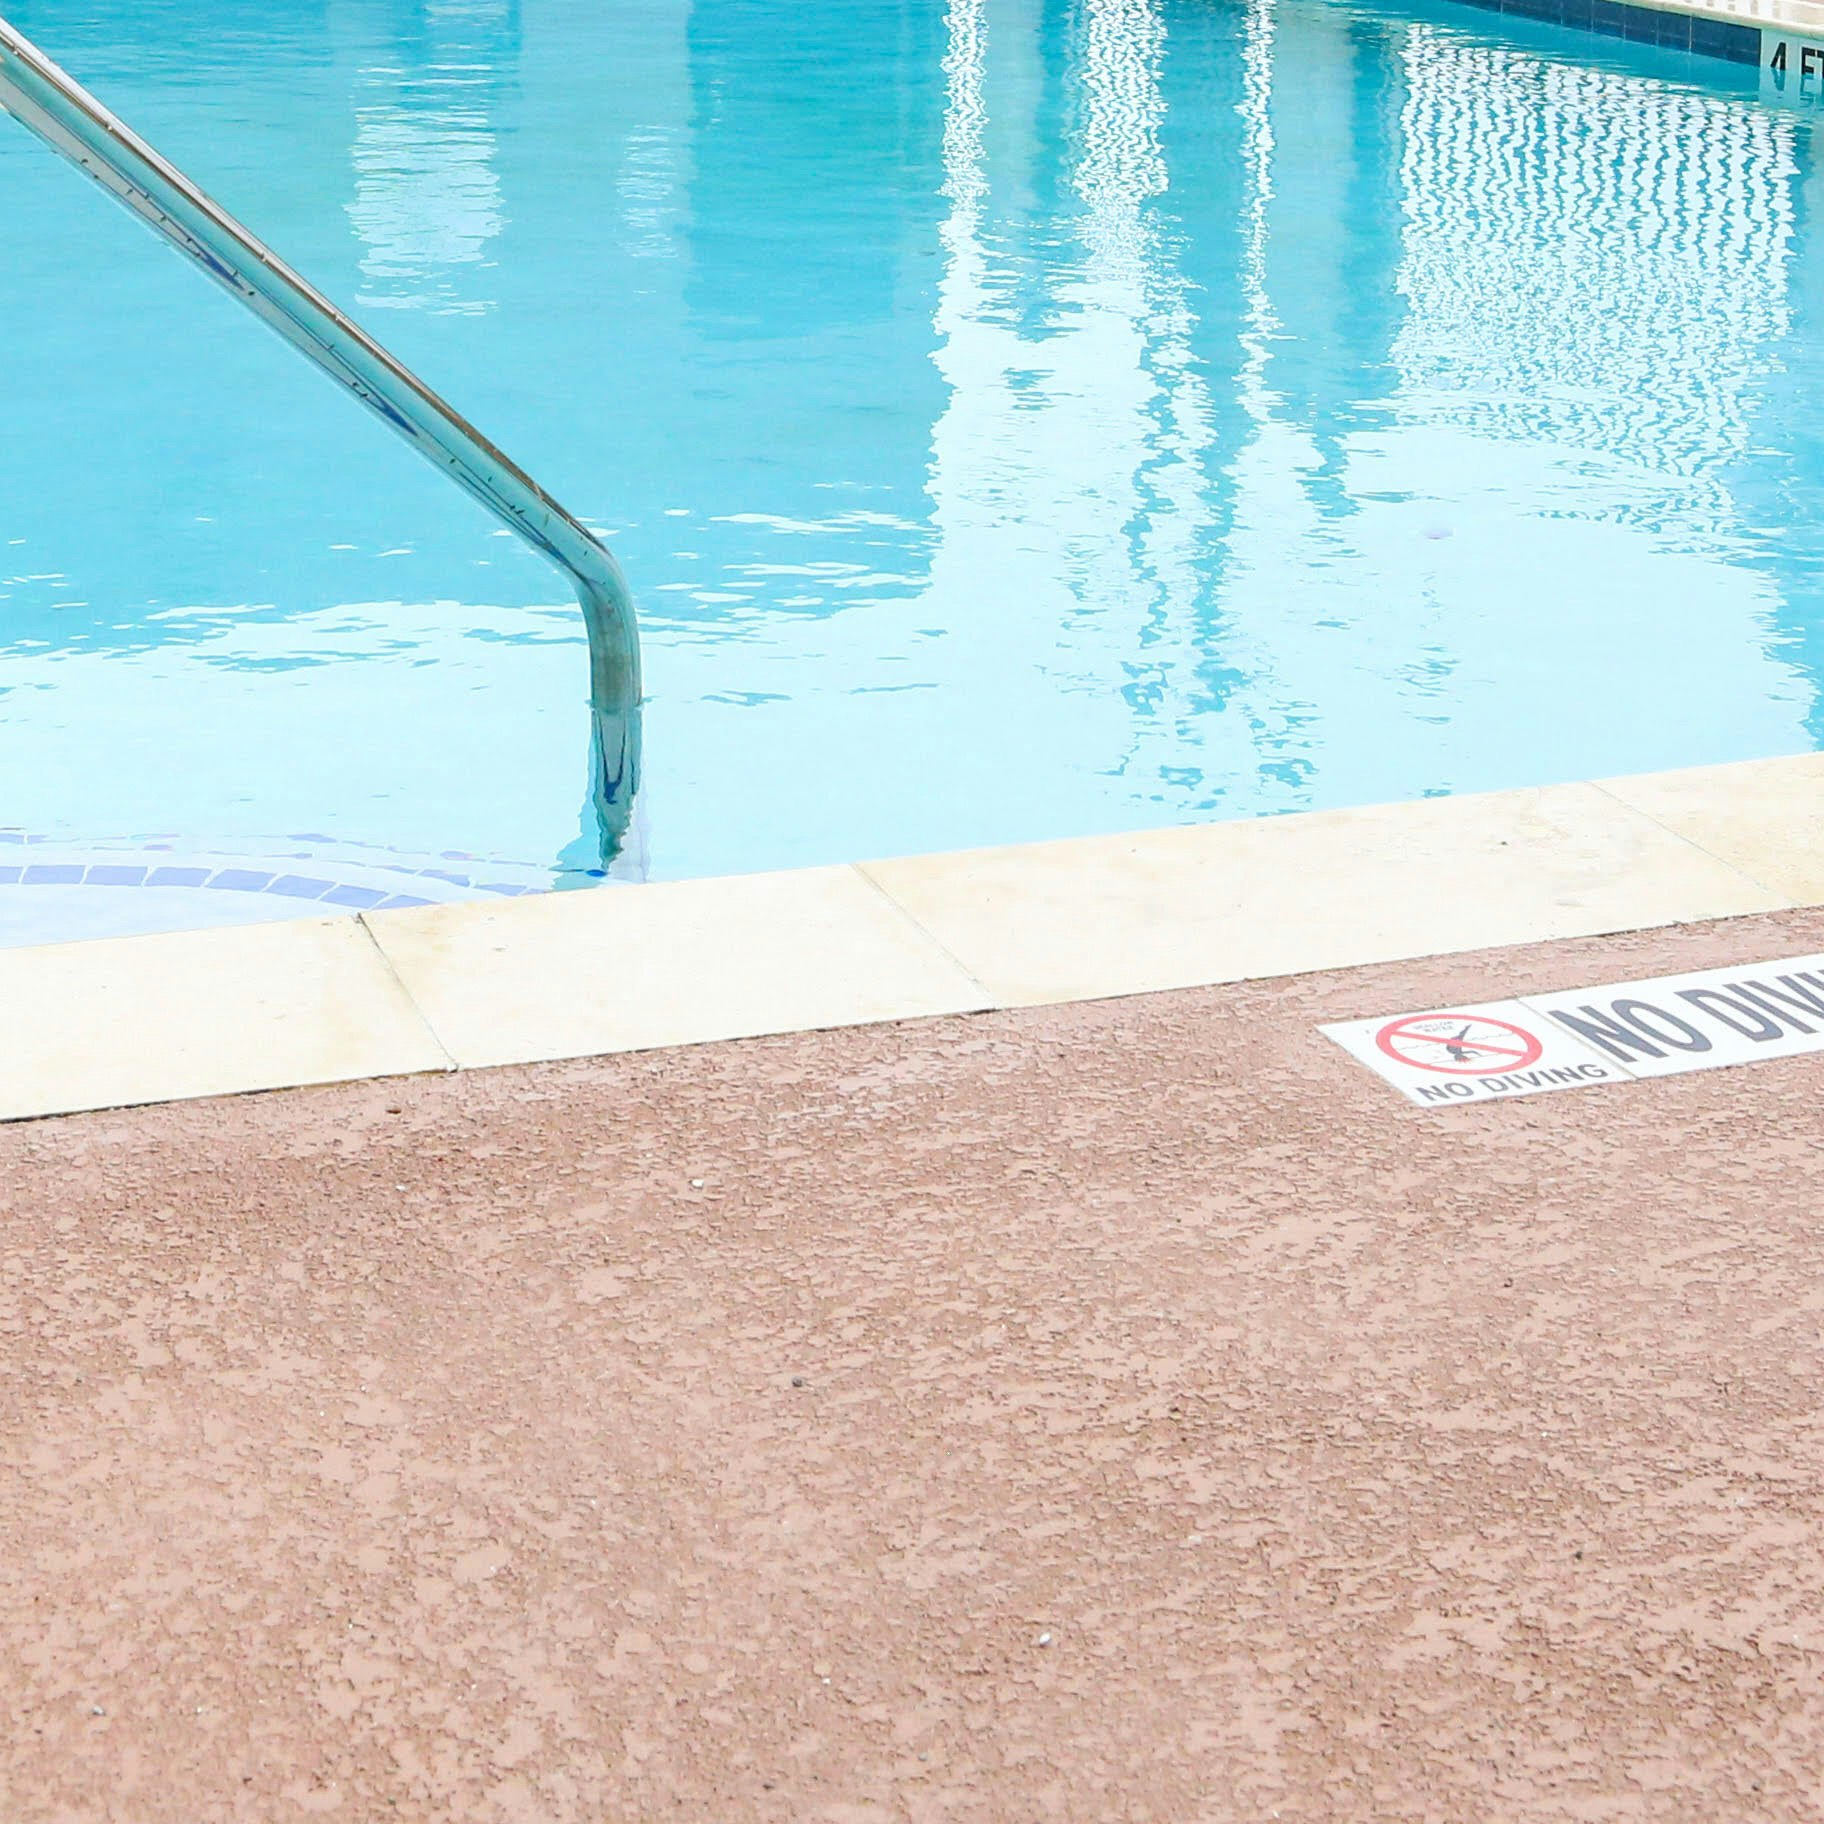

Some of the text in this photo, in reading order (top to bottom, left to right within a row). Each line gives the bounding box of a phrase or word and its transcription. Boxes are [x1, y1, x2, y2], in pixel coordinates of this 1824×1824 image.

[1547, 1000, 1712, 1064] NO
[1415, 1063, 1609, 1102] NO DIVING
